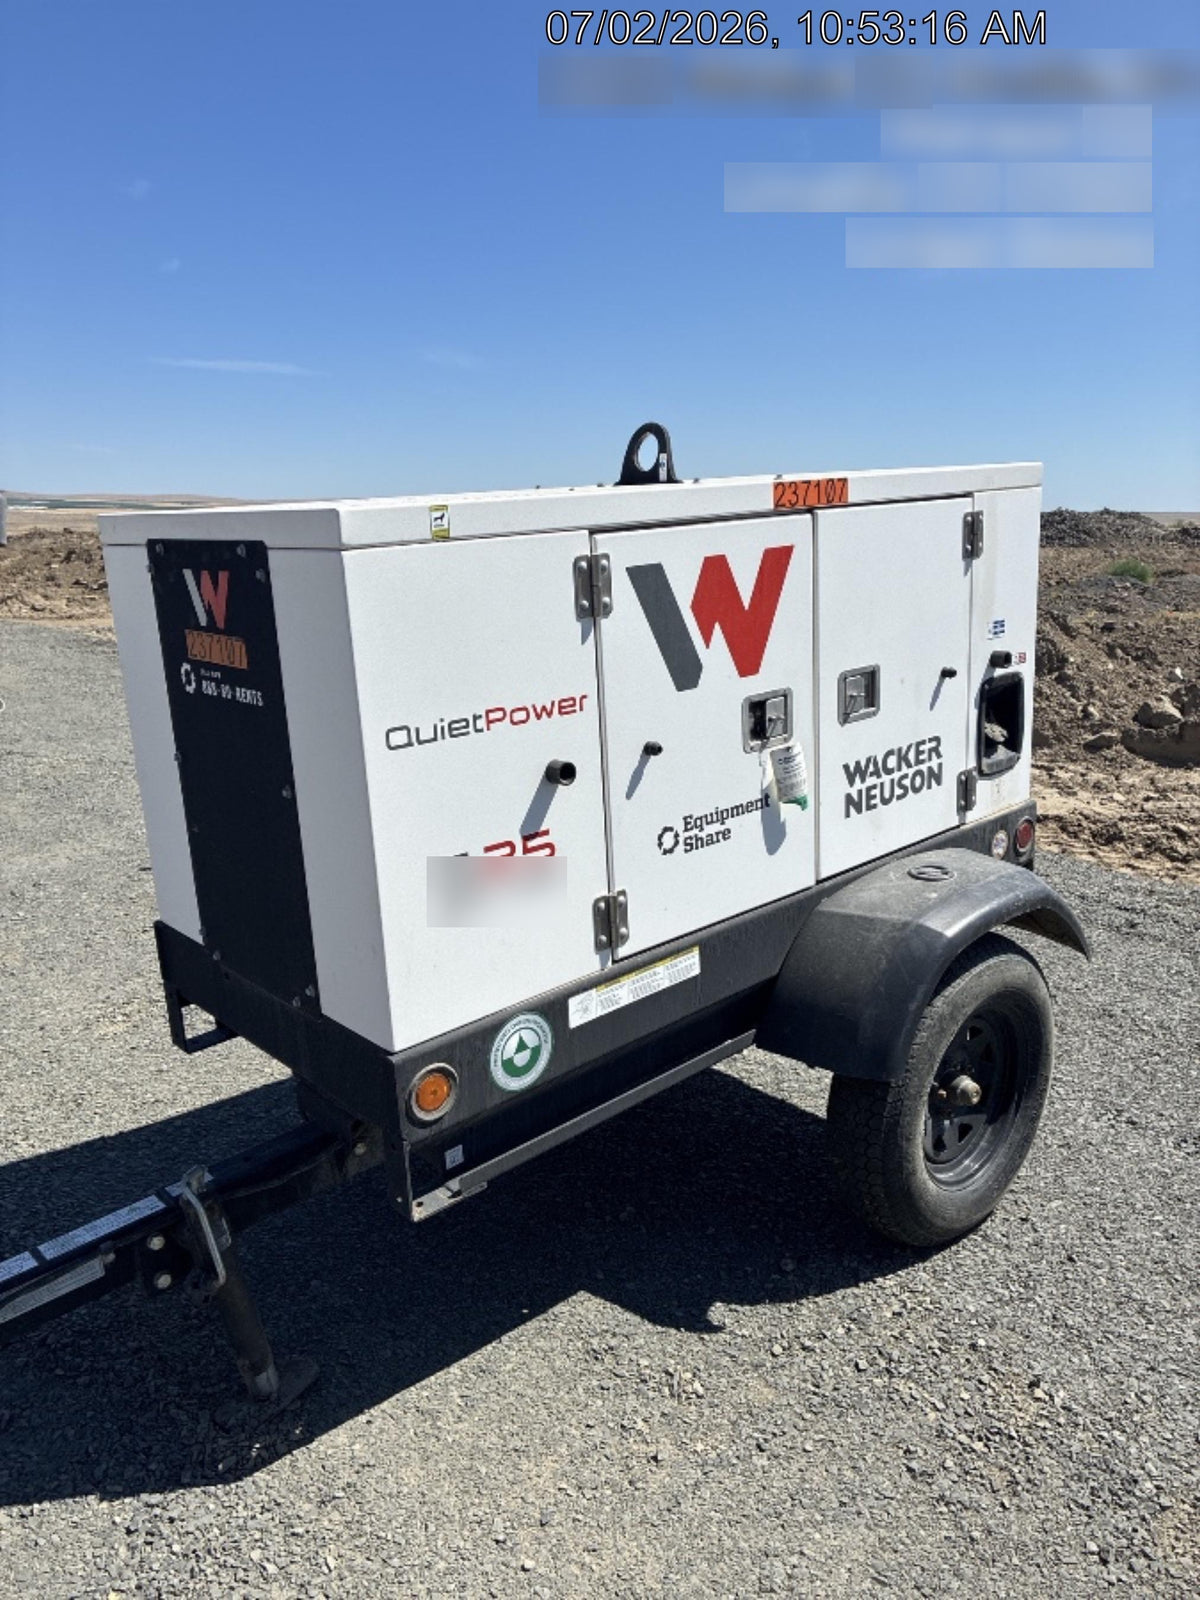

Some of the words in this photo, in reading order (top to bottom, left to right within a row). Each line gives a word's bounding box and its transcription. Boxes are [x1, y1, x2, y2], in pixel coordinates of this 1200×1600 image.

[773, 478, 848, 508] 237107
[385, 694, 588, 751] QuietPower
[842, 735, 943, 788] WACKER
[682, 793, 771, 833] Equipment
[844, 761, 943, 819] NEUSON
[683, 826, 731, 854] Share
